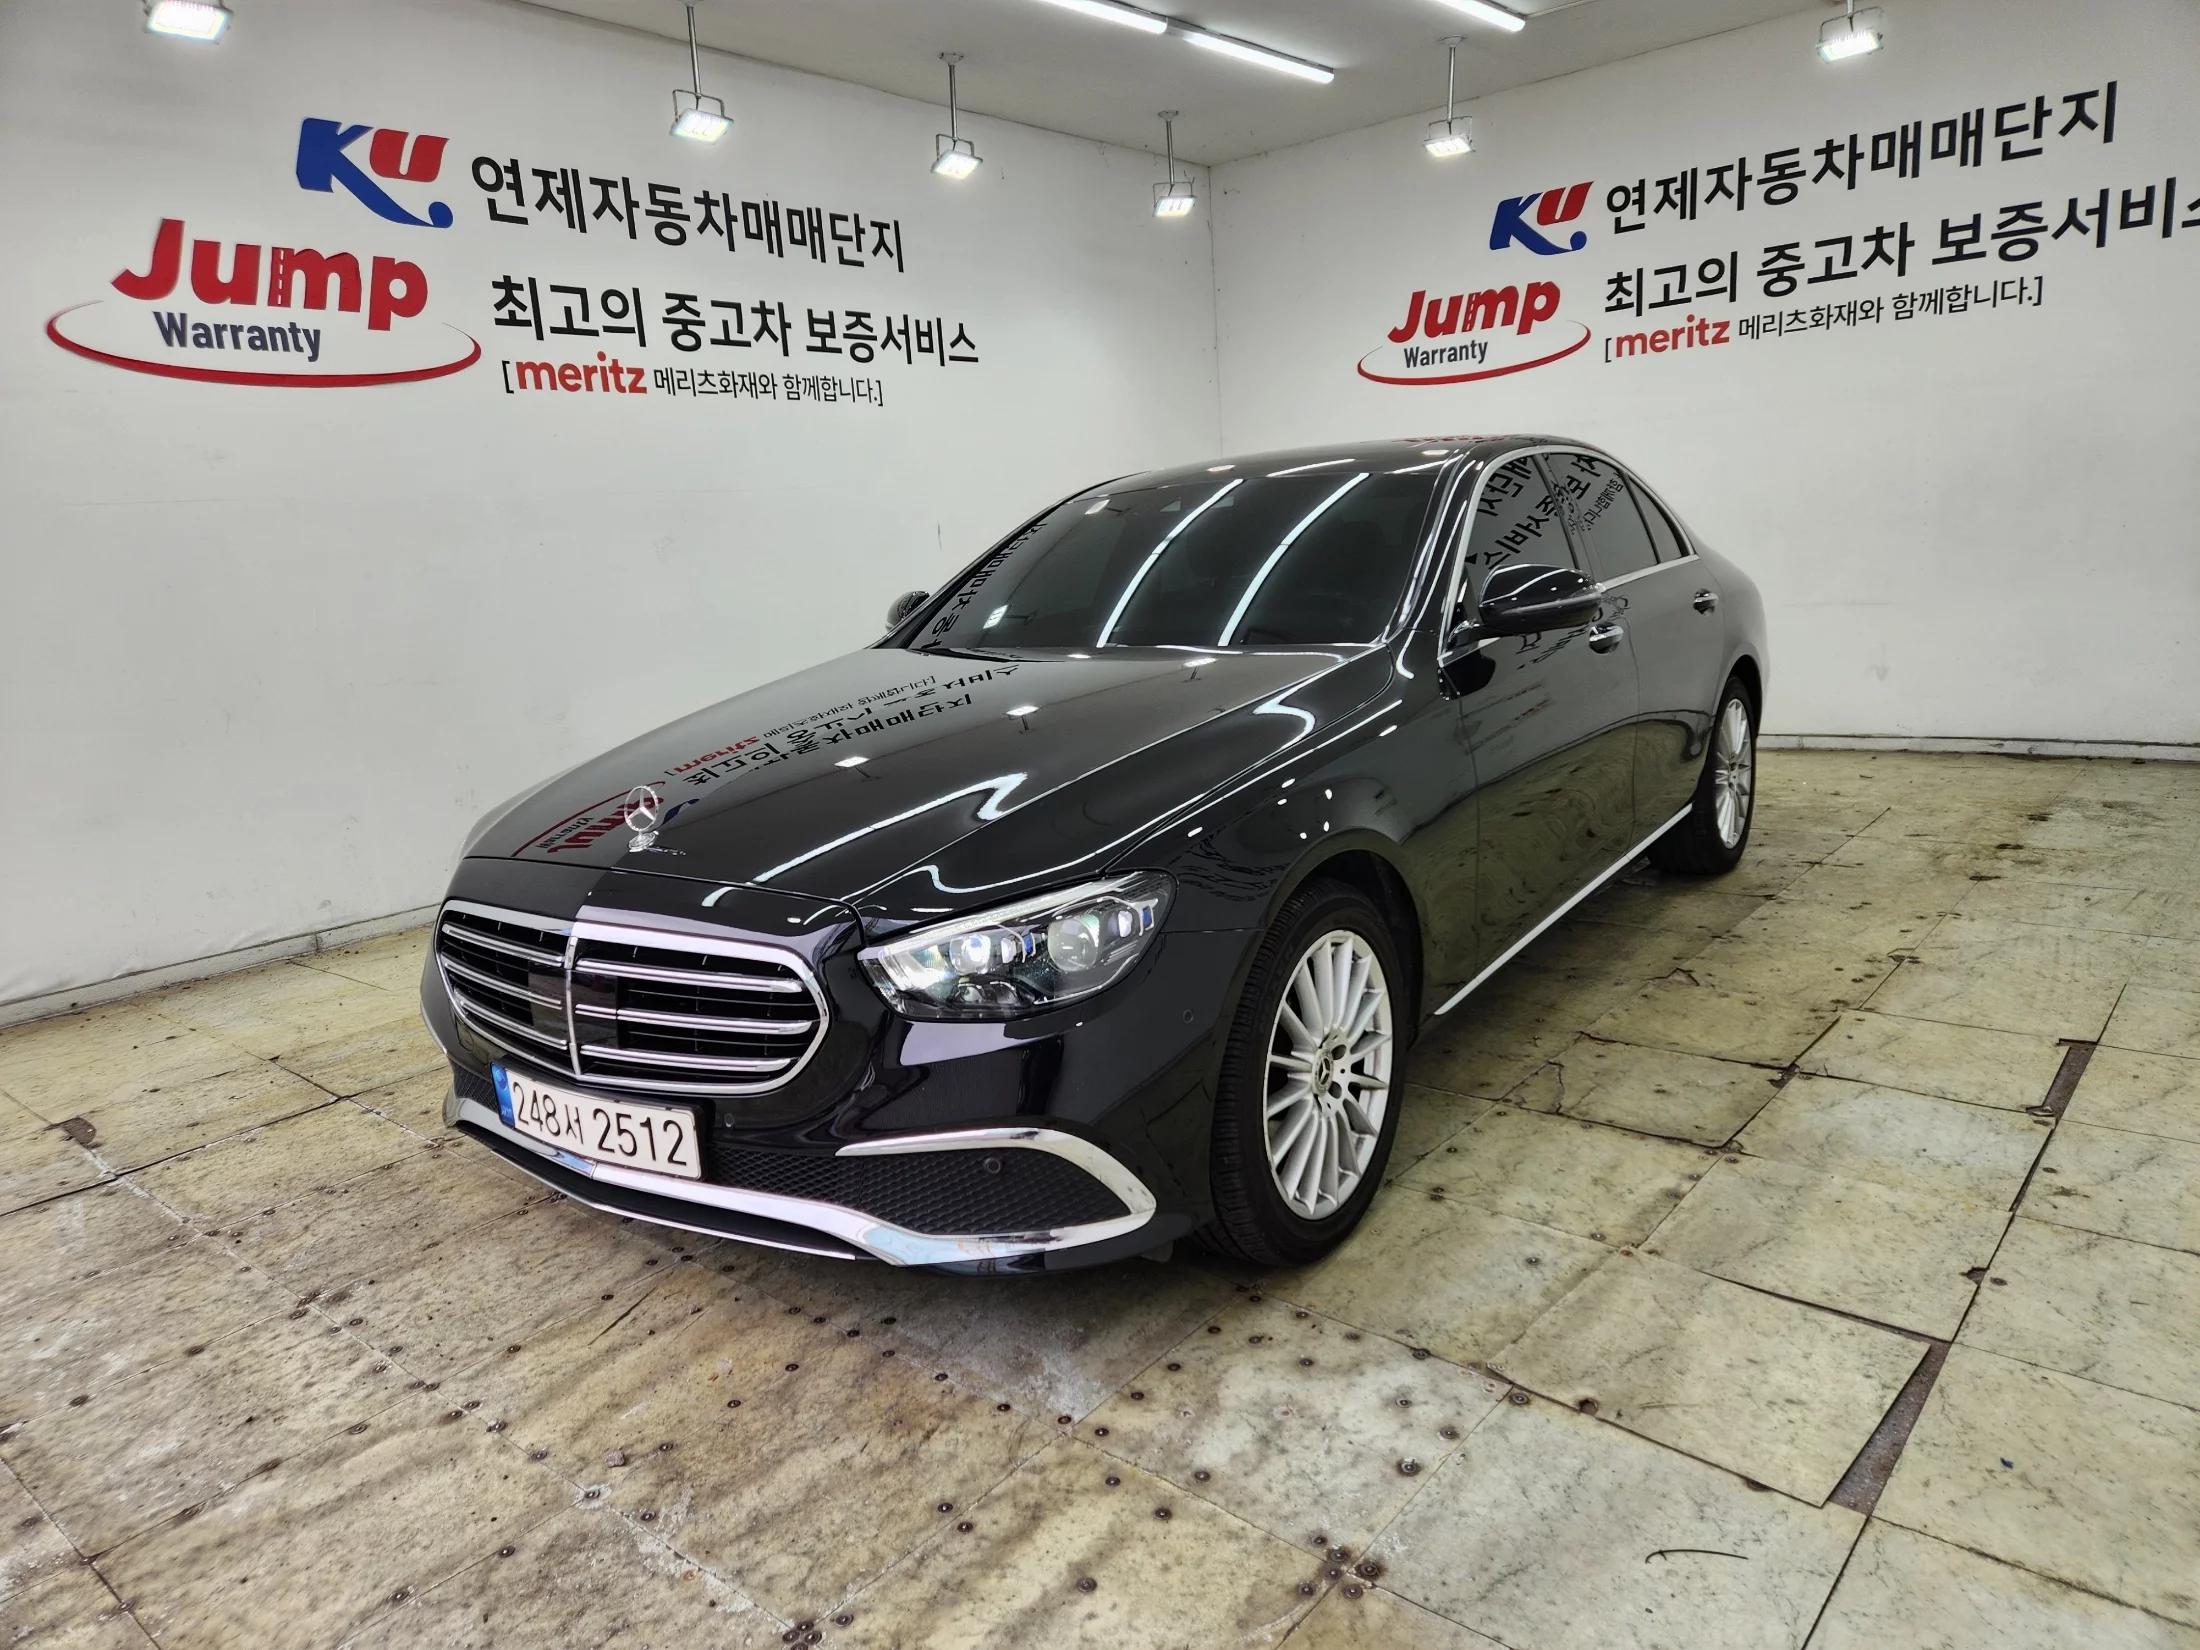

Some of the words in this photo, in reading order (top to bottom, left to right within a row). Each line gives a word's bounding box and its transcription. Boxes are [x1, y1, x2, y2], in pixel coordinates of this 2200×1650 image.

[1606, 80, 2118, 235] 연제자동차매매단지
[471, 156, 905, 273] 연제자동차매매단지
[111, 218, 428, 331] Jump
[1387, 280, 1561, 344] Jump
[1604, 250, 1738, 318] 최고의
[1756, 221, 1916, 298] 중고차
[153, 311, 321, 362] Warranty
[491, 274, 647, 348] 최고의
[661, 292, 792, 357] 중고차
[805, 308, 979, 367] 보증서비스
[1403, 340, 1489, 369] Warranty
[1738, 296, 1885, 340] 메리츠화재와
[653, 367, 778, 400] 메리츠화재와
[513, 1081, 584, 1145] 248서
[592, 1108, 687, 1167] 2512
